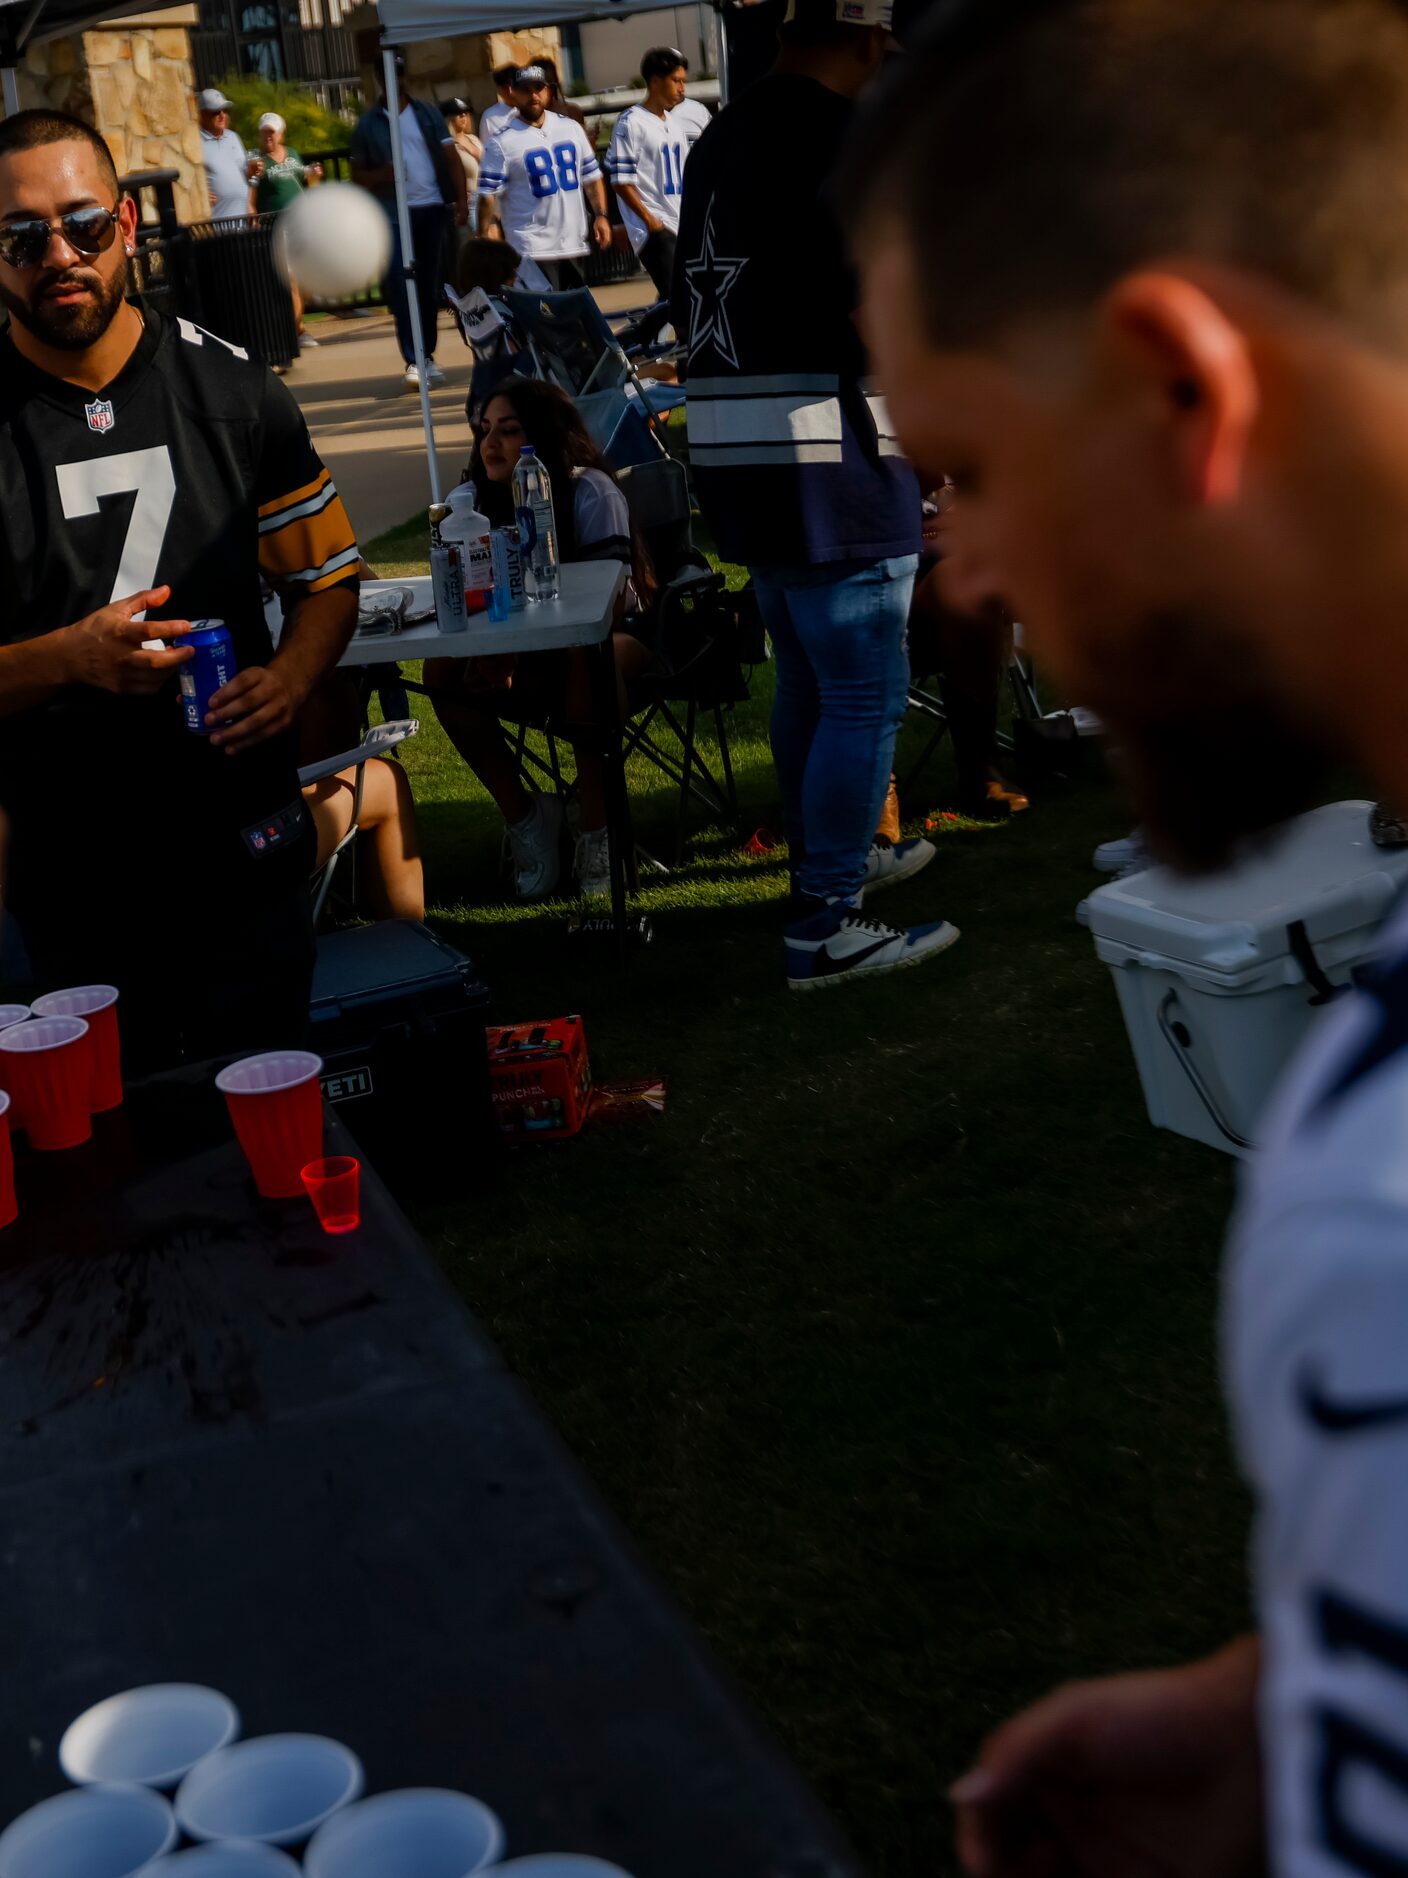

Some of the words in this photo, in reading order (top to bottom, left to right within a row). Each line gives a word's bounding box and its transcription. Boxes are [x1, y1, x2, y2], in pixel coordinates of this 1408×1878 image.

[524, 142, 579, 198] 88
[661, 143, 683, 194] 11
[91, 412, 111, 428] NFL
[55, 445, 176, 651] 7
[450, 569, 463, 617] ULTRA
[506, 547, 523, 600] TRULY
[320, 1072, 366, 1098] ETI
[492, 1085, 534, 1103] PUNCH
